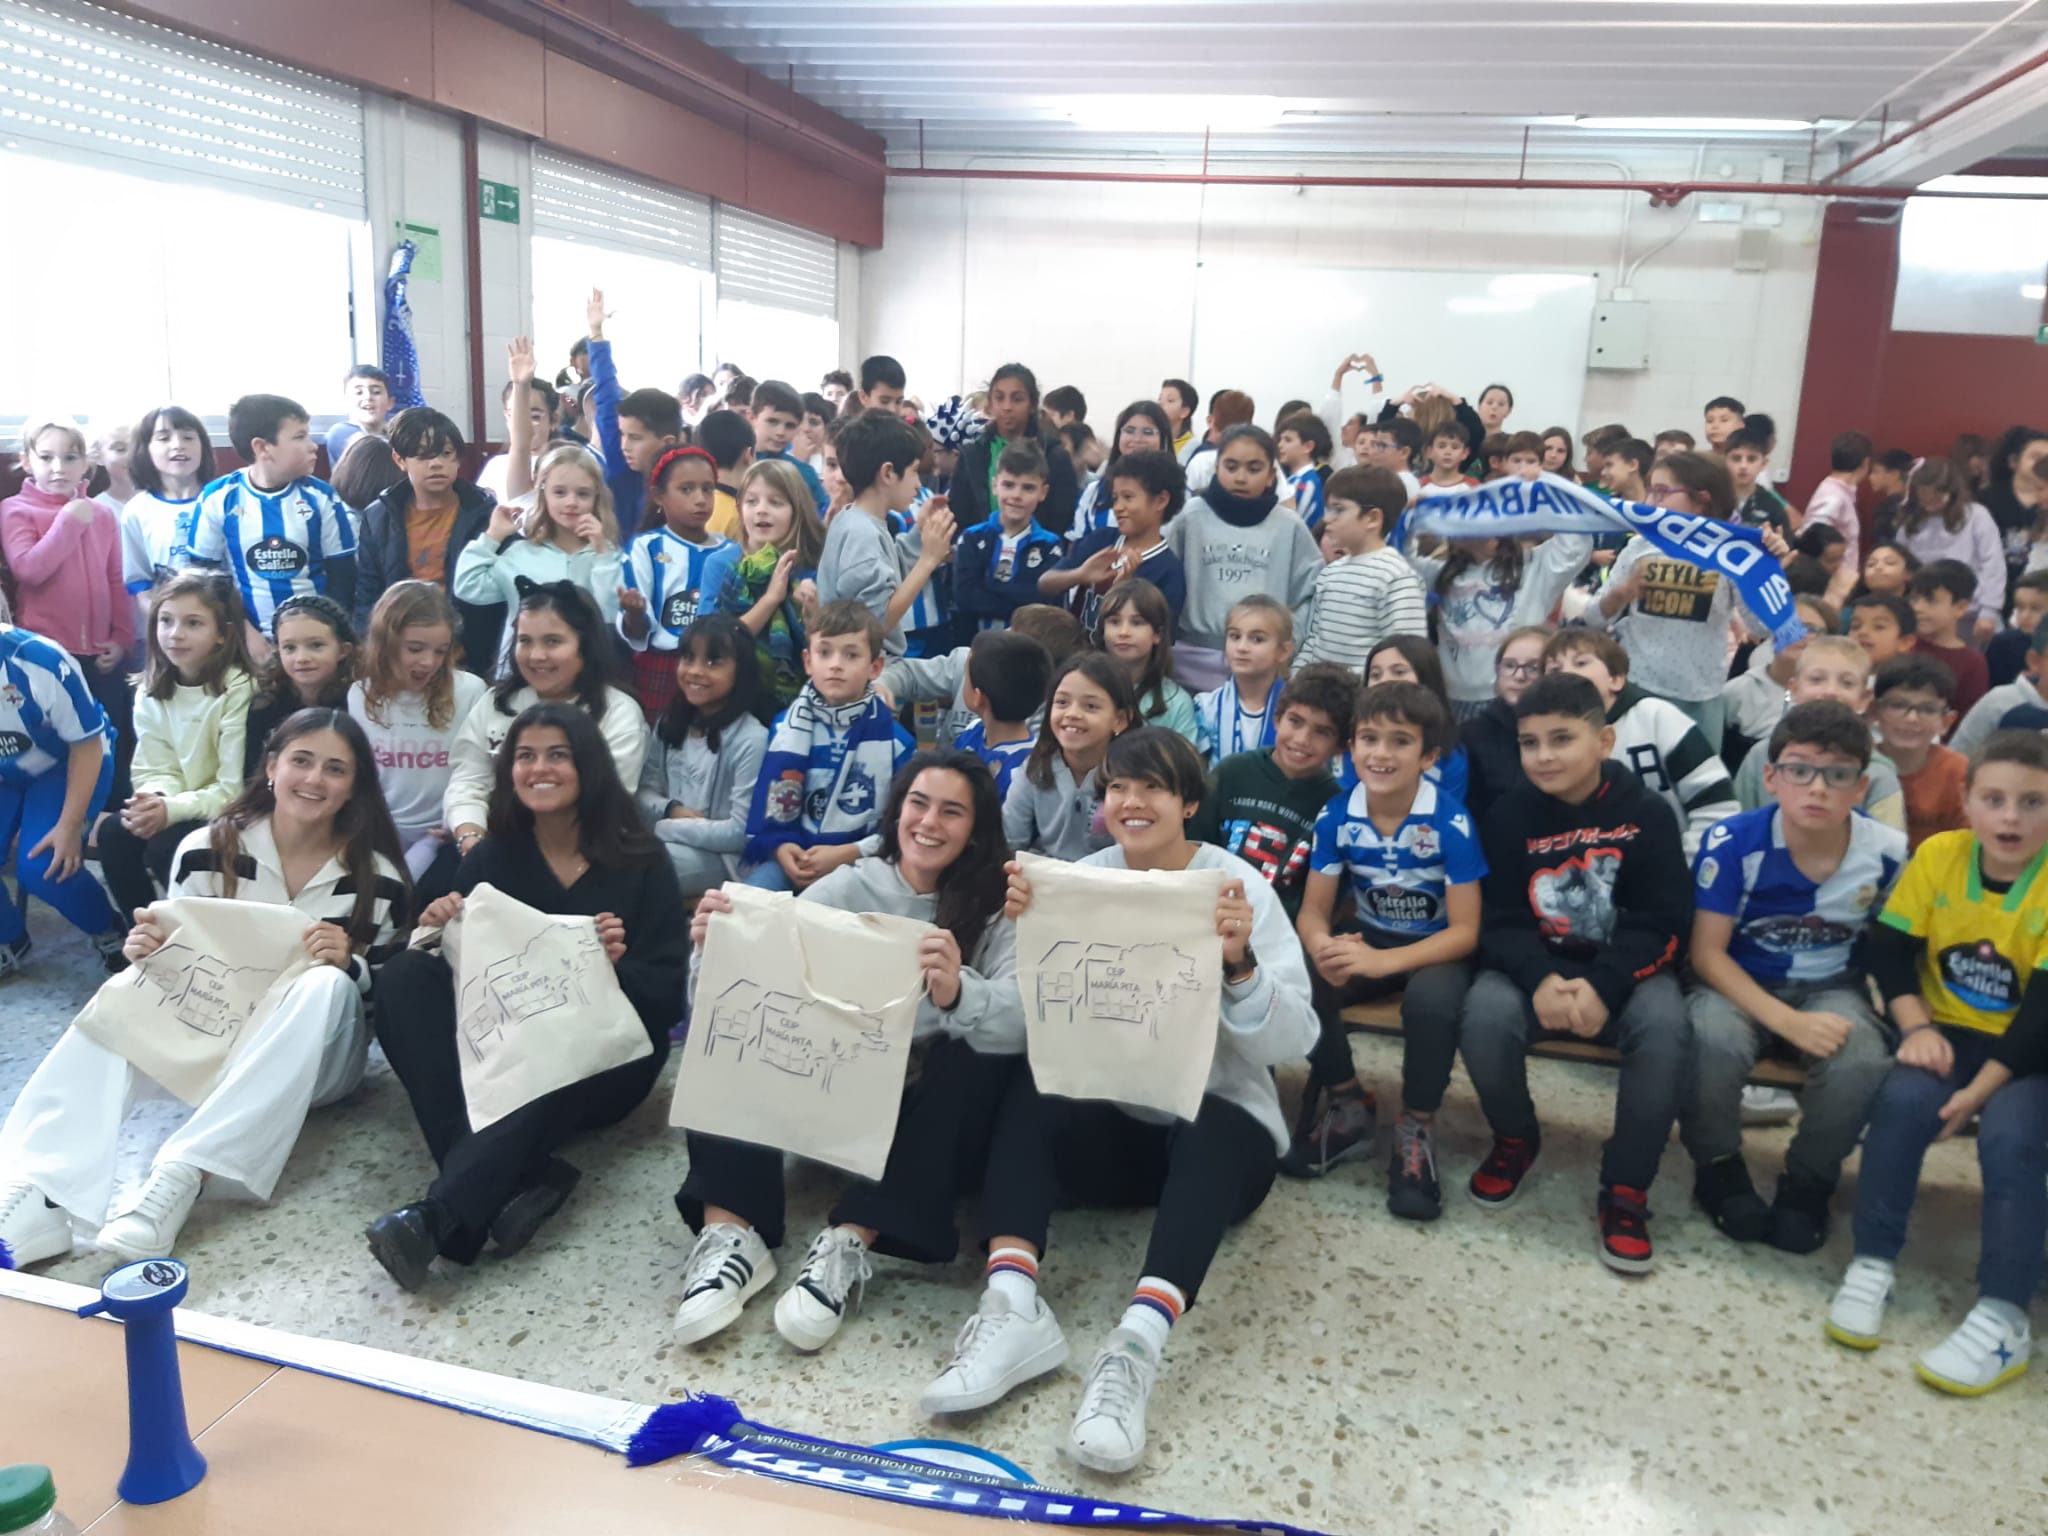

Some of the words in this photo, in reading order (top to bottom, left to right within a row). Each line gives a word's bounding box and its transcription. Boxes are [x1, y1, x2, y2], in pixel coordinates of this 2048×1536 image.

[1610, 499, 1764, 576] DEPO
[254, 548, 297, 559] Estrella
[256, 559, 295, 570] Galicia
[1217, 567, 1251, 584] 1997
[1644, 590, 1696, 617] ICON
[1949, 951, 2012, 983] Estrella
[1120, 982, 1141, 993] PITA
